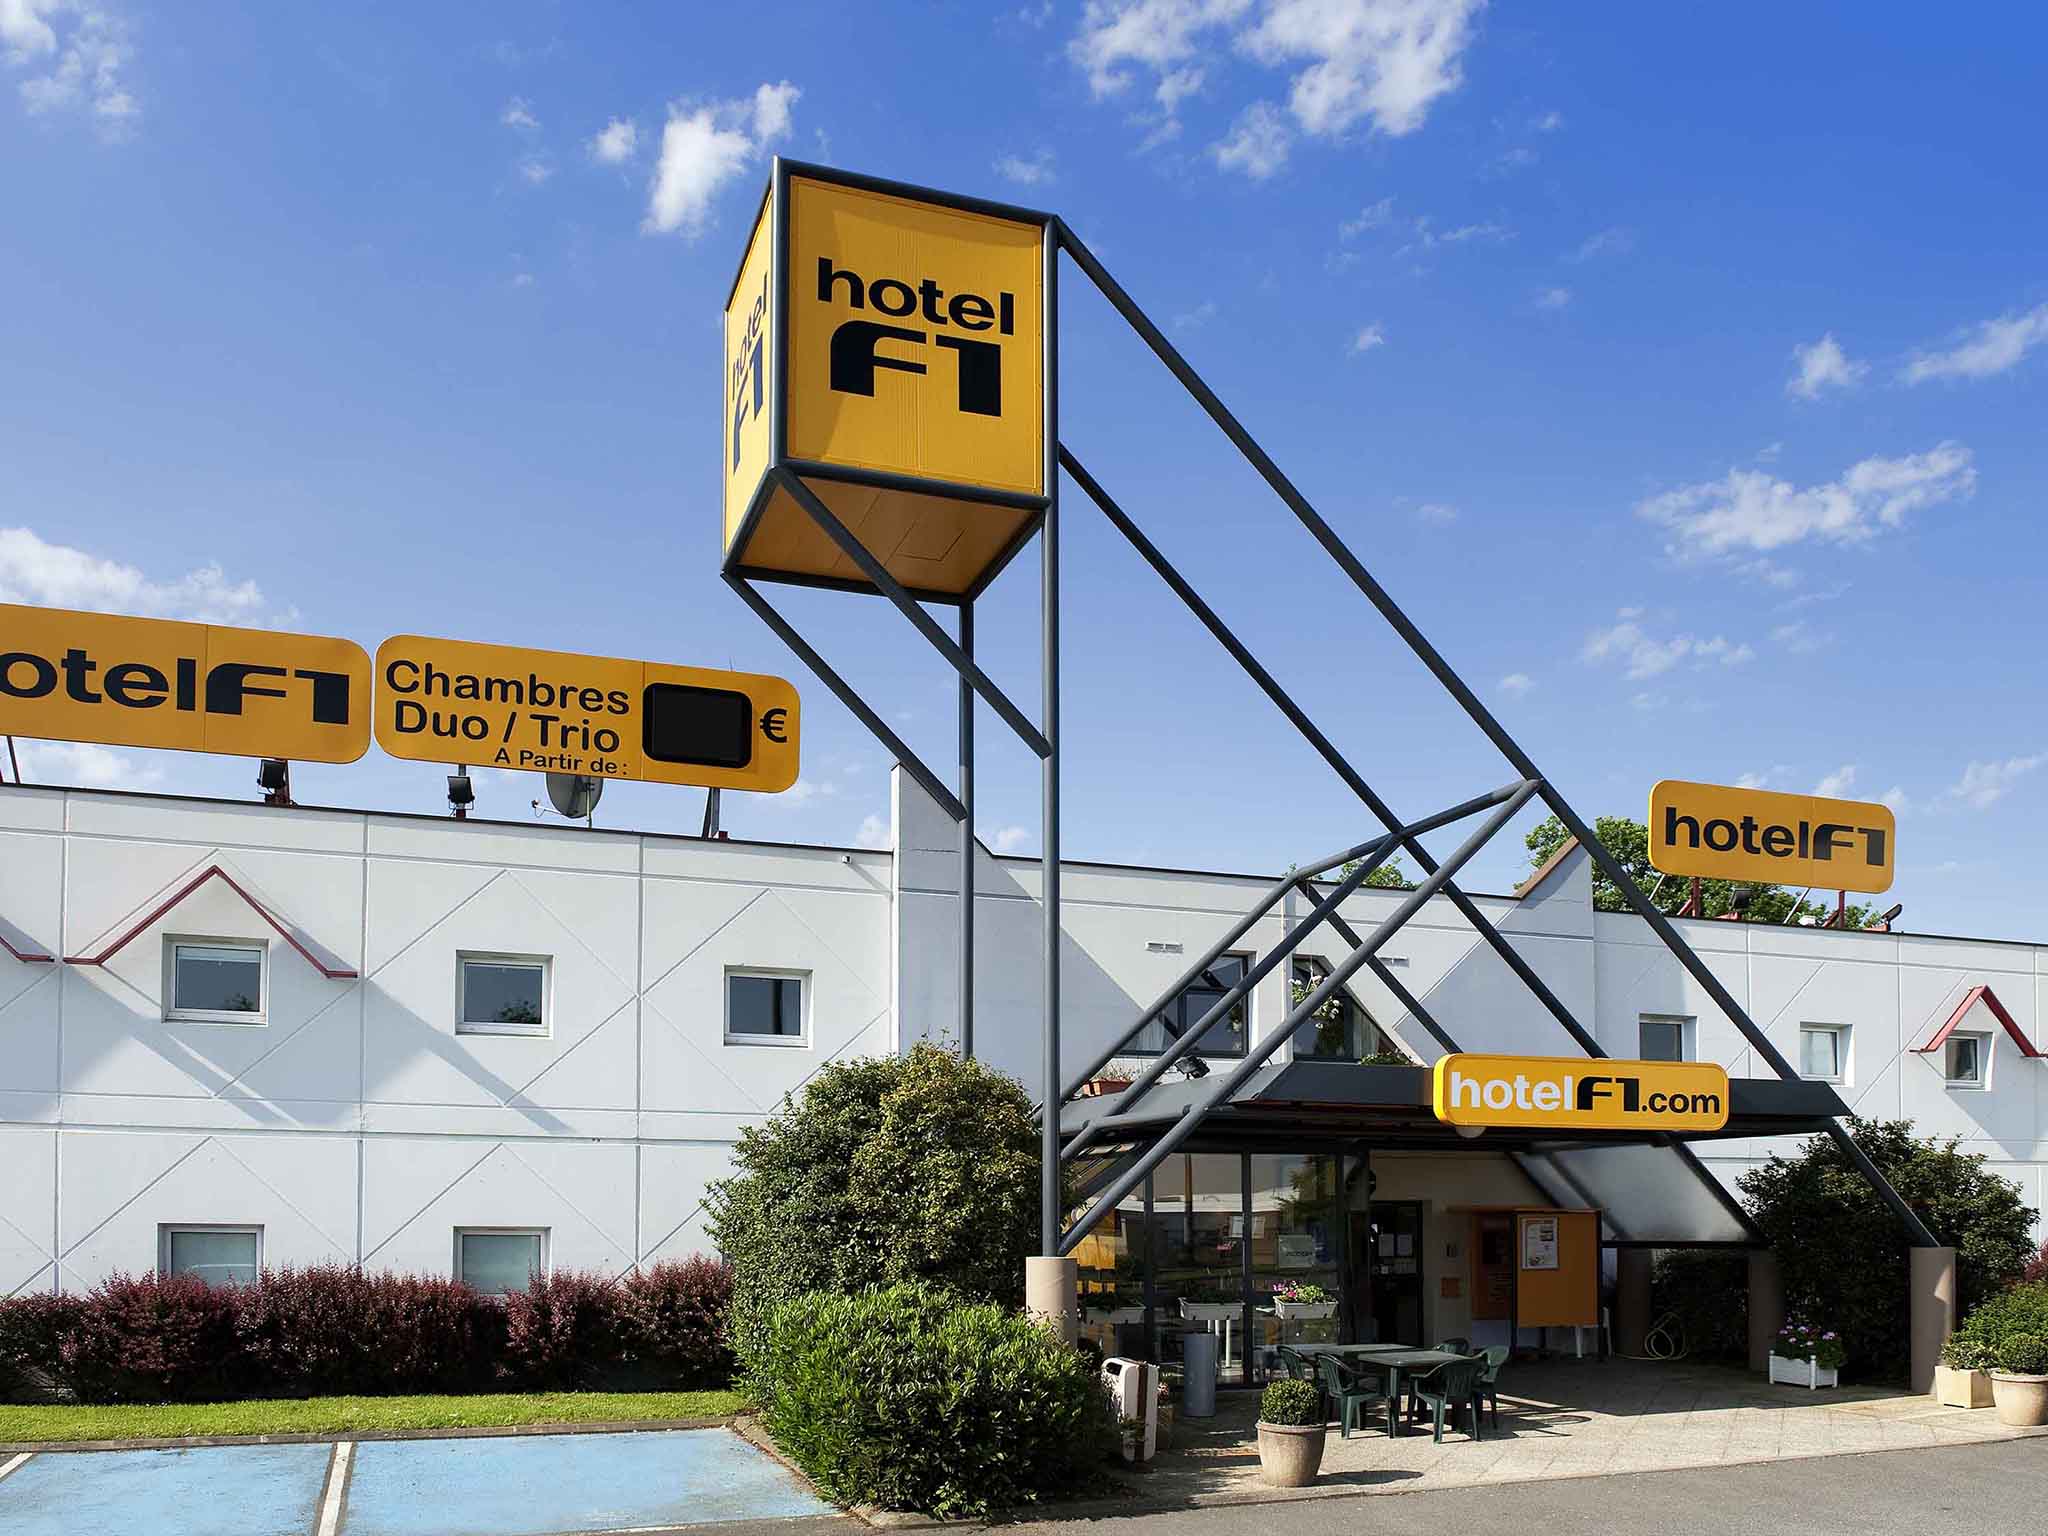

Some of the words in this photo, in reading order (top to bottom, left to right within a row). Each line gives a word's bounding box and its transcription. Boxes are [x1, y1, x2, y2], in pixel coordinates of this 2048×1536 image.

[818, 256, 1015, 336] hotel
[732, 271, 768, 402] hotel
[829, 319, 1002, 418] F1
[733, 331, 764, 475] F1
[0, 648, 350, 725] otelF1
[386, 659, 630, 716] Chambres
[394, 700, 490, 742] Duo
[503, 711, 517, 744] /
[530, 714, 621, 754] Trio
[759, 707, 788, 744] €
[494, 747, 512, 765] A
[518, 750, 582, 772] Partir
[1665, 806, 1886, 867] hotelF1
[1450, 1071, 1721, 1114] hotelF1.com
